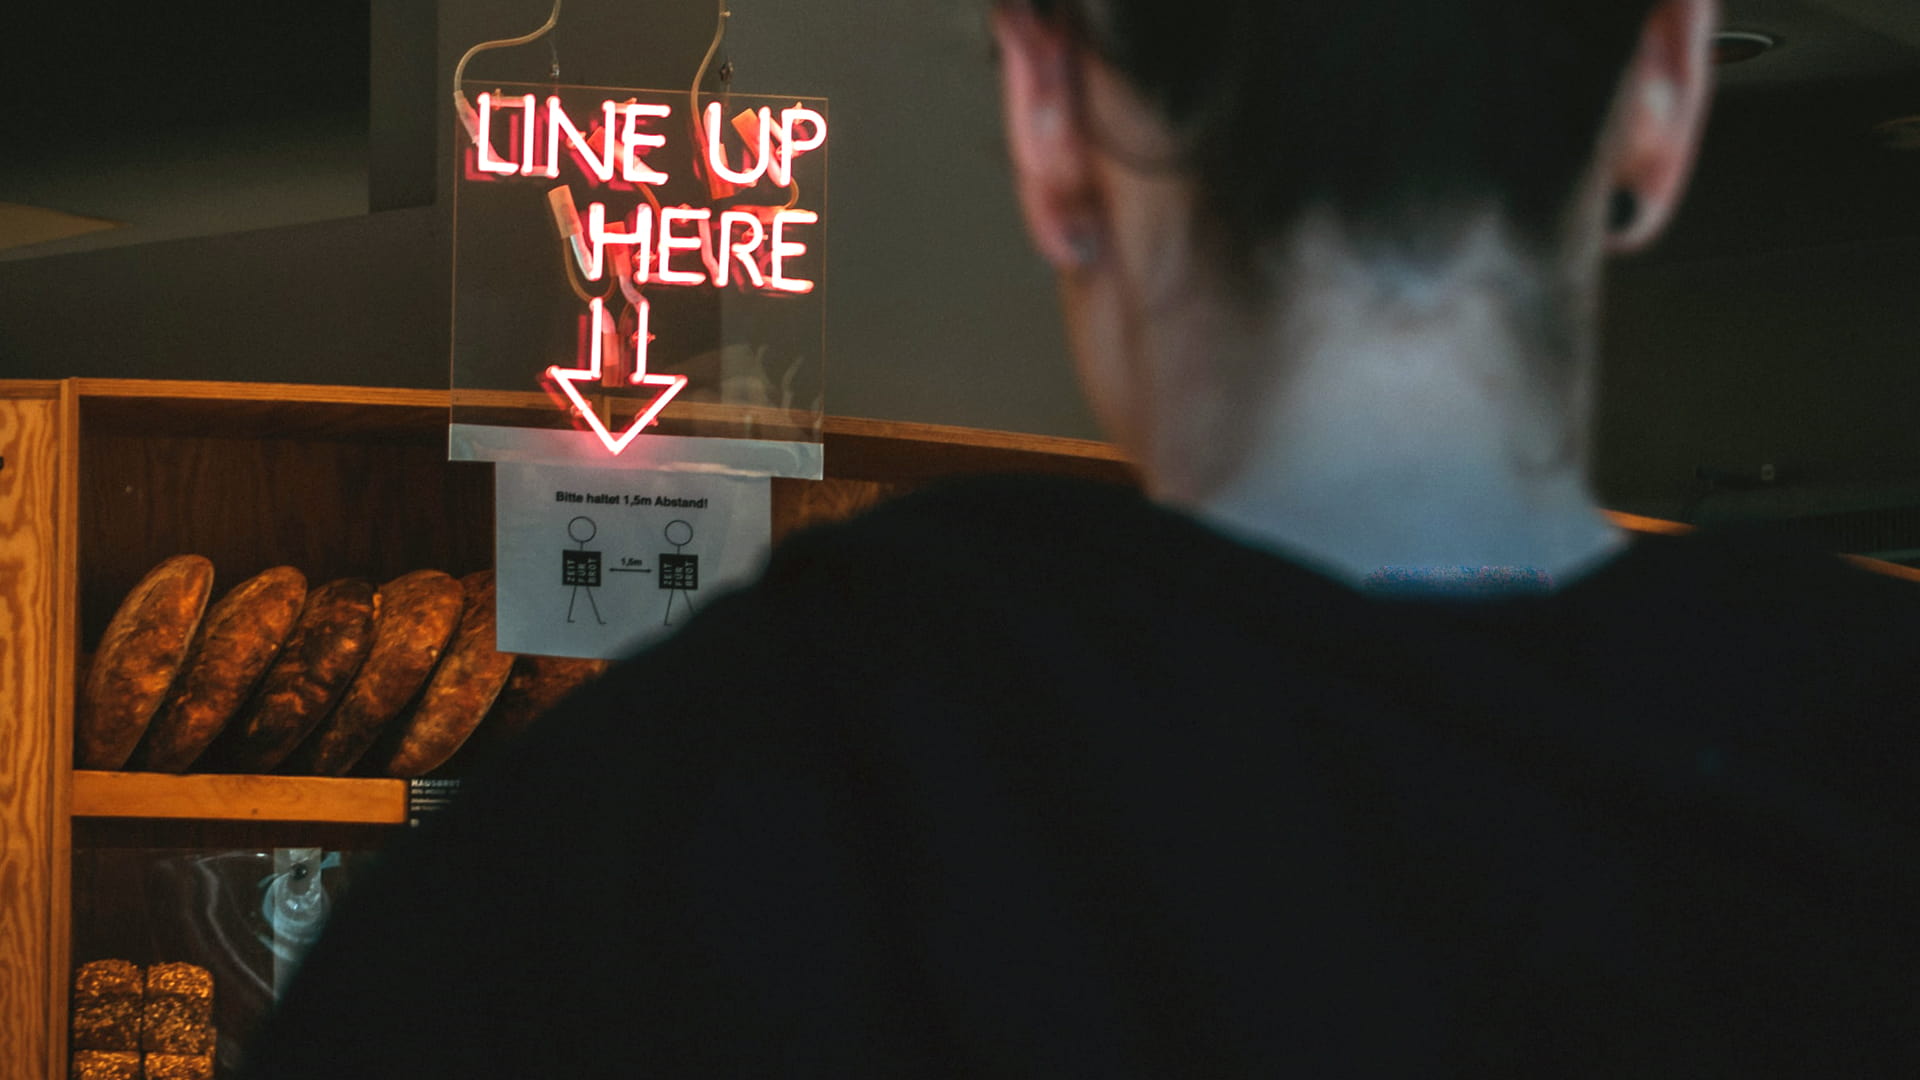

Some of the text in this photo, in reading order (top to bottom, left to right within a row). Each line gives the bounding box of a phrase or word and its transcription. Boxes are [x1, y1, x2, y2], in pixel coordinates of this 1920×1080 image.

[477, 92, 828, 187] LINE UP
[588, 202, 818, 293] HERE
[556, 491, 708, 509] Bitte haltet 1,5m Abstand!
[567, 559, 576, 582] ZEIT
[621, 557, 643, 567] 1,5m
[663, 563, 673, 585] ZEIT
